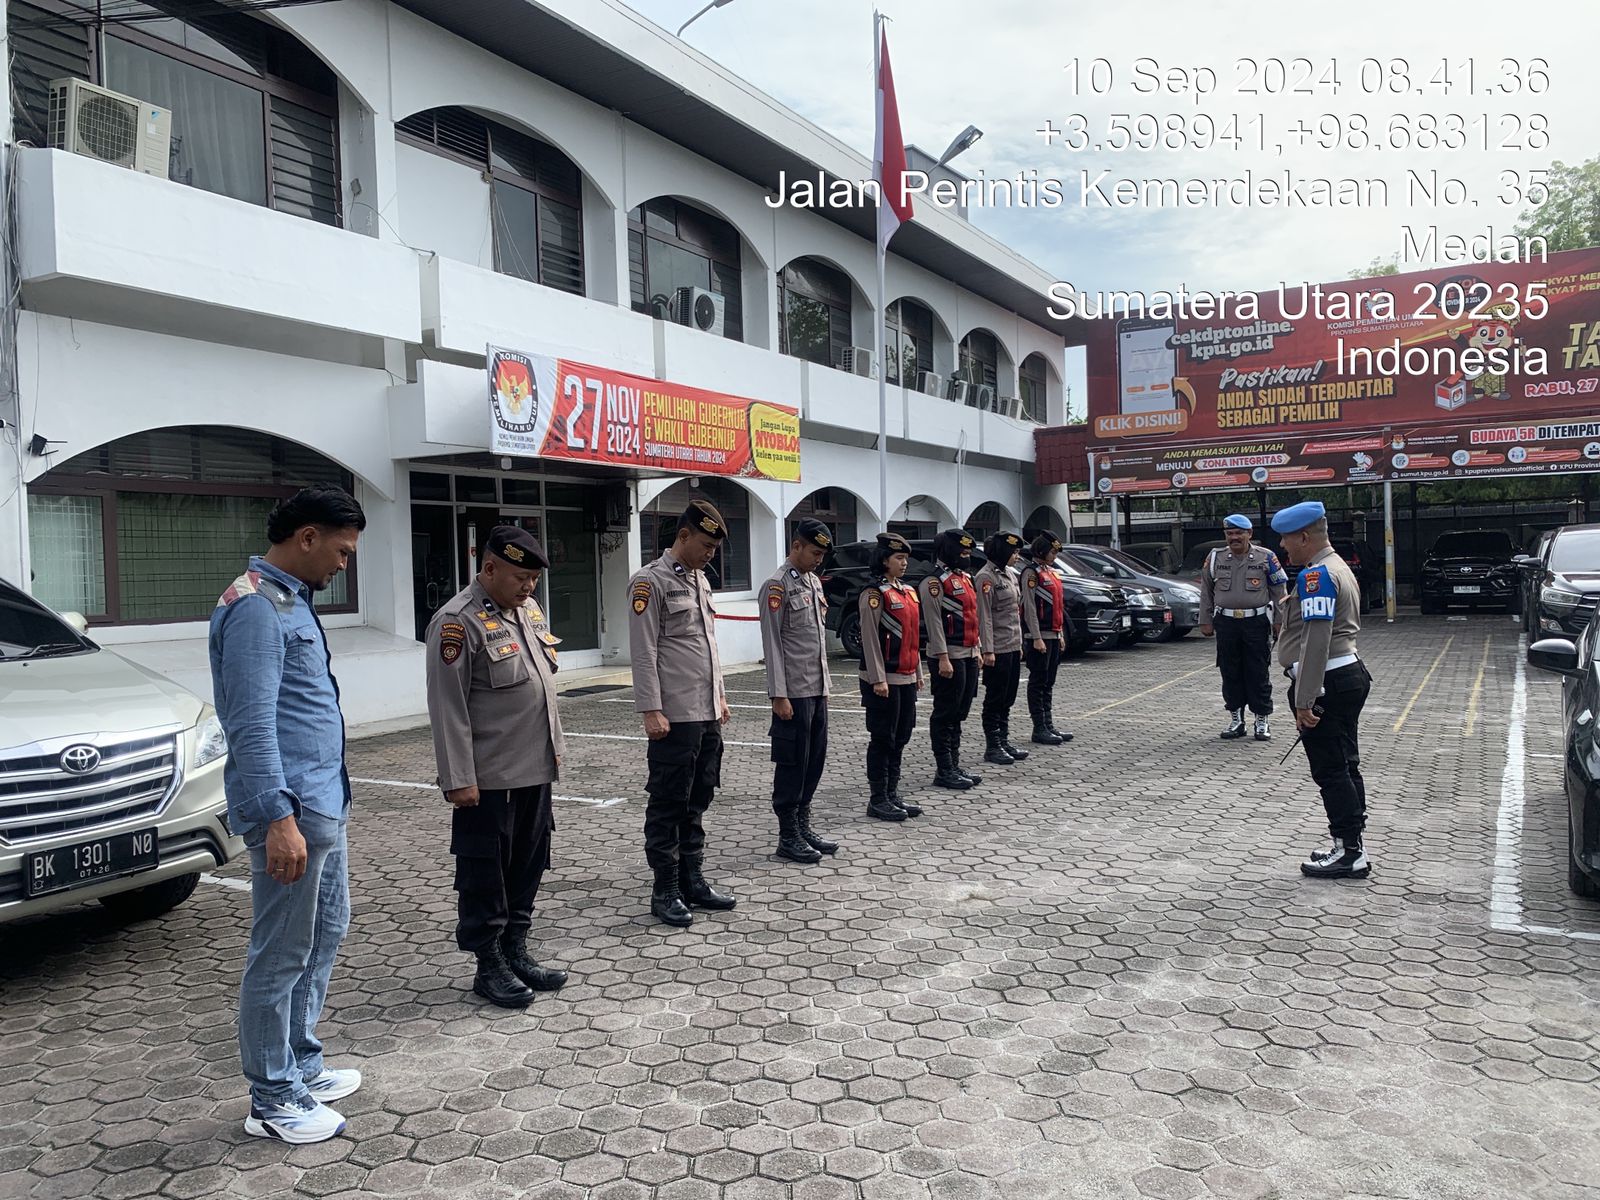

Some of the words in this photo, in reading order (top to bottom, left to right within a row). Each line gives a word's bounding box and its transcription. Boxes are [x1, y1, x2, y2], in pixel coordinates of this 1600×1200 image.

[1171, 320, 1295, 345] cekdptonline.
[1327, 320, 1355, 330] KOMISI
[1362, 323, 1400, 333] SUMATERA
[1400, 320, 1424, 329] UTARA
[500, 352, 527, 365] KOMISI
[1191, 335, 1274, 360] kpu.go.id
[1218, 359, 1323, 390] Pastikan!
[1577, 378, 1598, 393] 27
[606, 383, 641, 426] NOV
[1217, 391, 1254, 410] ANDA
[1258, 387, 1305, 407] SUDAH
[1310, 378, 1394, 402] TERDAFTAR
[492, 394, 525, 432] PEMILIHAN
[564, 374, 604, 450] 27
[643, 391, 696, 422] PEMILIHAN
[699, 402, 746, 430] GUBERNUR
[1100, 414, 1131, 431] KLIK
[1134, 413, 1182, 428] DISINI!
[1217, 408, 1276, 428] SEBAGAI
[1279, 401, 1340, 424] PEMILIH
[607, 423, 640, 456] 2024
[644, 416, 651, 440] &
[654, 417, 686, 445] WAKIL
[688, 423, 736, 451] GUBERNUR
[1471, 428, 1517, 444] BUDAYA
[1519, 426, 1536, 441] 5R
[1538, 425, 1551, 439] DI
[1553, 423, 1600, 438] TEMPAT
[644, 442, 674, 459] SUMATERA
[675, 446, 694, 461] UTARA
[694, 448, 712, 463] TAHUN
[712, 450, 726, 465] 2024
[1156, 461, 1192, 471] MENUJU
[1202, 458, 1228, 468] ZONA
[1229, 455, 1283, 466] INTEGRITAS
[1163, 451, 1189, 459] ANDA
[1190, 446, 1239, 457] MEMASUKI
[1240, 443, 1284, 453] WILAYAH
[1301, 596, 1336, 618] ROV
[34, 854, 55, 879] BK
[73, 841, 110, 869] 1301
